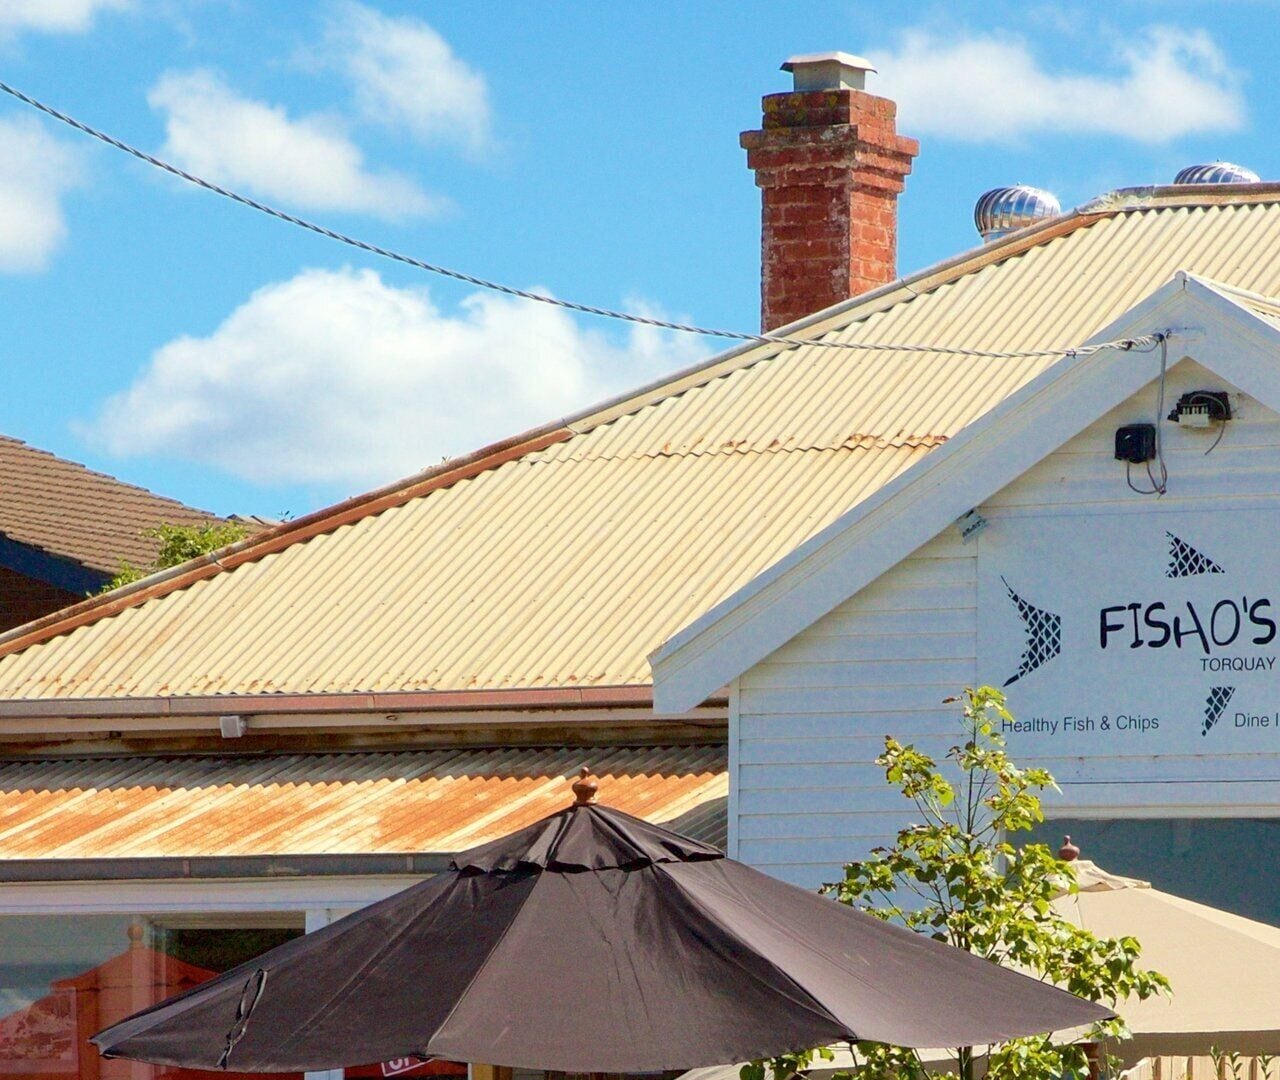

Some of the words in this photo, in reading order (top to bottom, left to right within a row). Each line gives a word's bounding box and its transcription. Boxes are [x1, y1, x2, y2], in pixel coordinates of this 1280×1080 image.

[1100, 596, 1276, 655] FISHO'S
[1200, 656, 1276, 672] TORQUAY
[1001, 717, 1059, 735] Healthy
[1063, 716, 1095, 732] Fish
[1100, 715, 1111, 731] &
[1116, 714, 1160, 733] Chips
[1234, 712, 1270, 728] Dine
